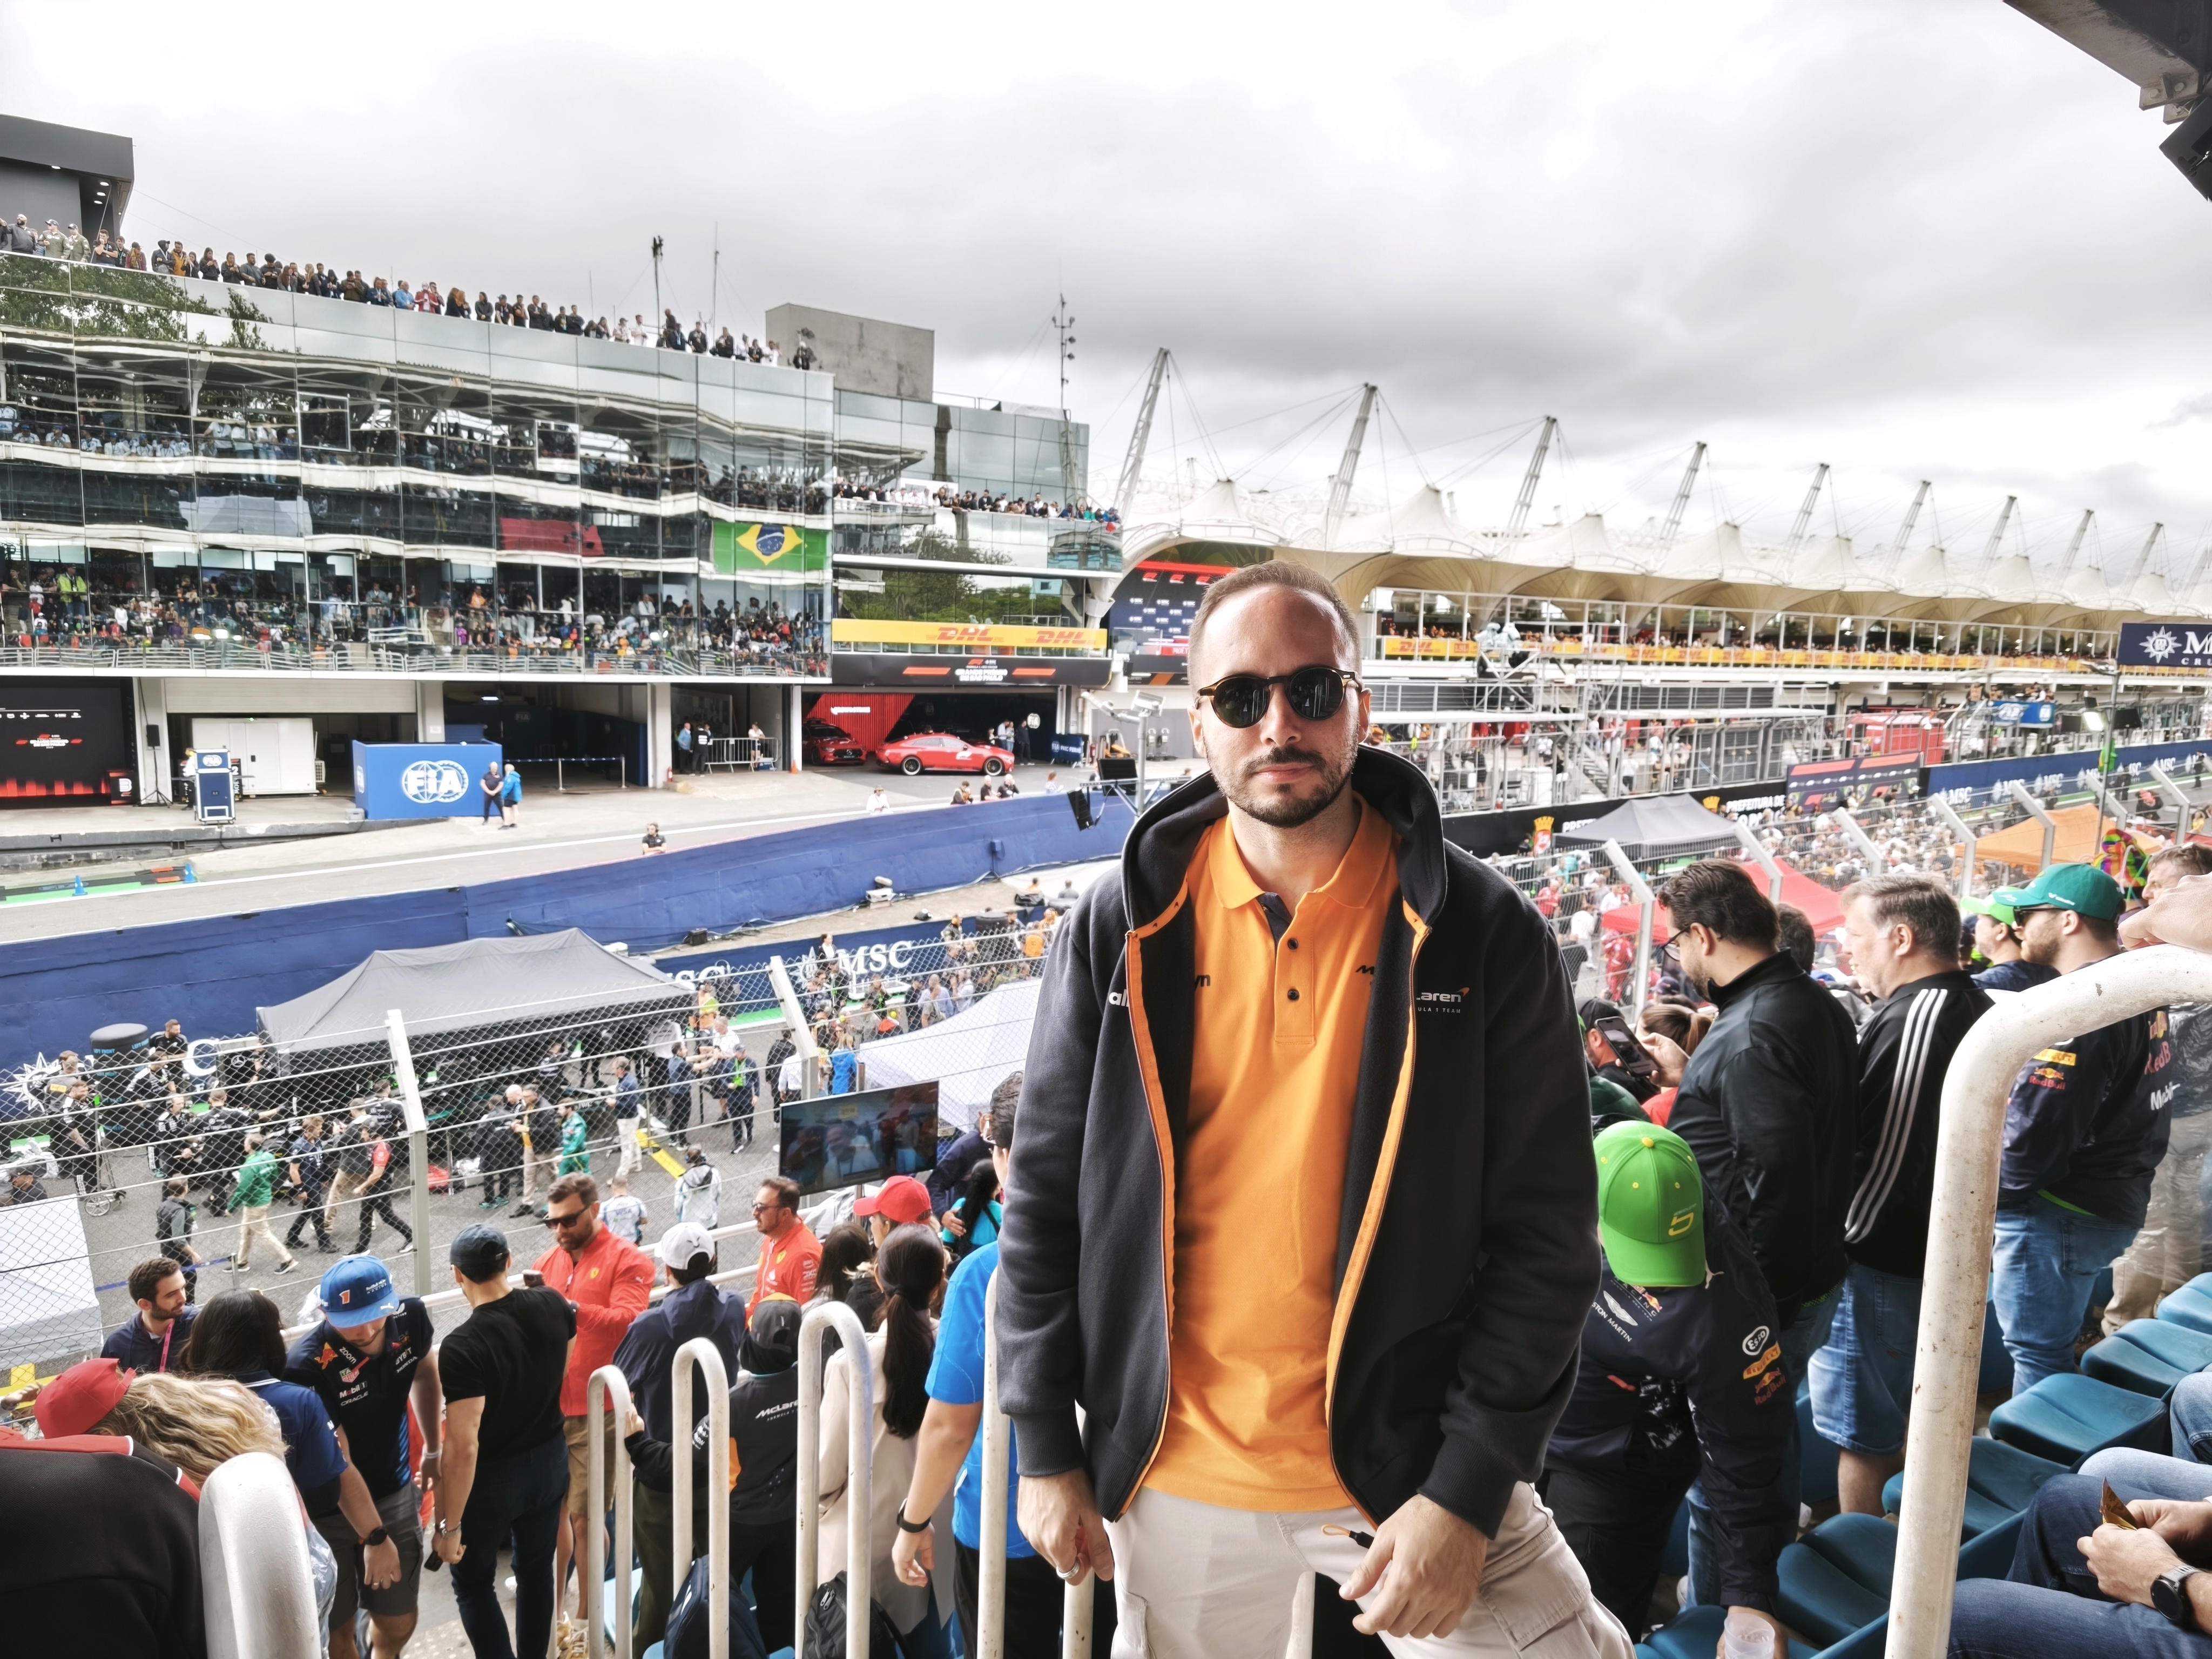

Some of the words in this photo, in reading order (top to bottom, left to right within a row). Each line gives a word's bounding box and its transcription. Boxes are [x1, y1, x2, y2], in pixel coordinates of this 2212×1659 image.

[937, 626, 994, 642] DHL
[1035, 630, 1088, 644] DHL
[1399, 642, 1434, 652] DHL
[2044, 773, 2064, 791] MSC
[1725, 796, 1773, 813] PREFEITURA
[1773, 794, 1786, 808] DE
[1948, 786, 1972, 805] MSC
[835, 940, 913, 975] MSC
[339, 1290, 350, 1304] 1
[1607, 1318, 1633, 1343] MARTIN
[339, 1346, 357, 1365] zoom
[396, 1355, 418, 1373] HONDA
[339, 1384, 360, 1399] Mobil
[341, 1391, 368, 1406] ORACLE
